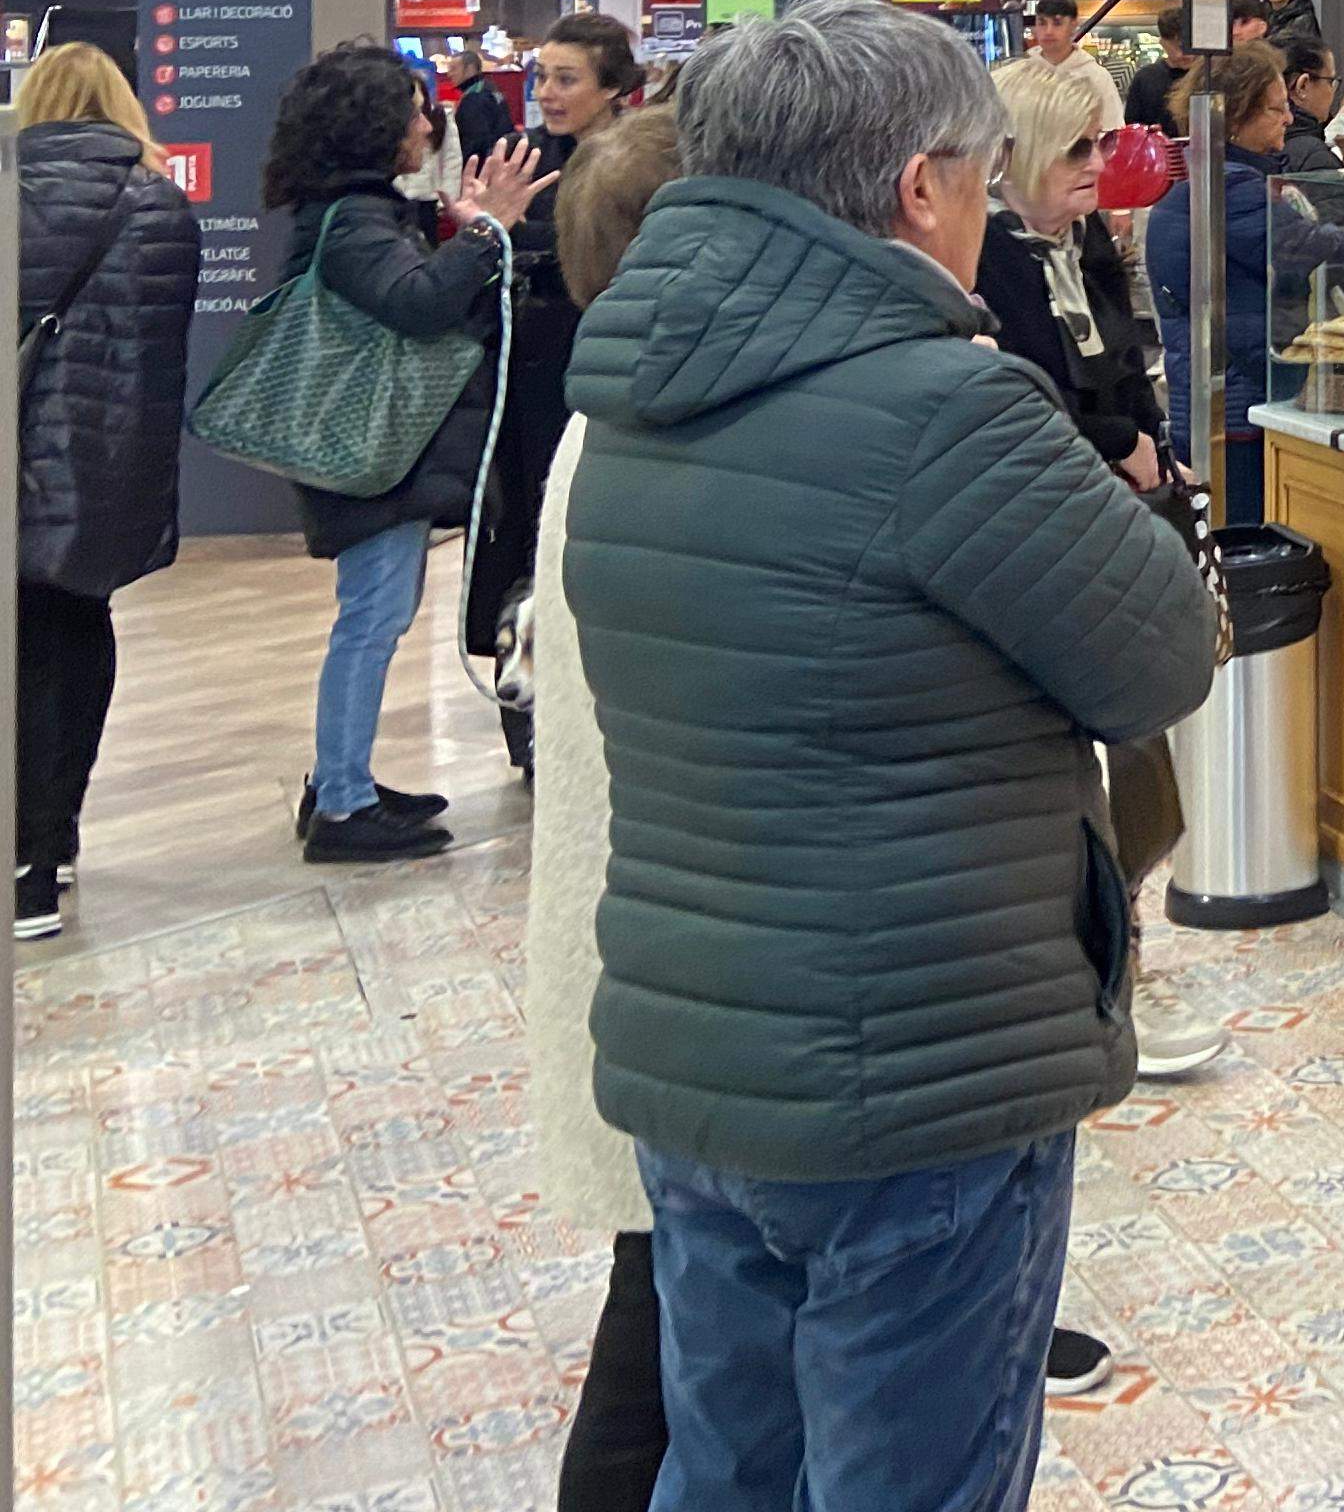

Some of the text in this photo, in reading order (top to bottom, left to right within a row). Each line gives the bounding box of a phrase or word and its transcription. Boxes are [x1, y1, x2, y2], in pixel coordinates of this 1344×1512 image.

[180, 8, 211, 20] LLAR
[220, 4, 293, 19] DECORACIÓ
[179, 35, 239, 50] ESPORTS
[179, 65, 251, 78] PAPERERIA
[178, 95, 242, 109] JOGUINES
